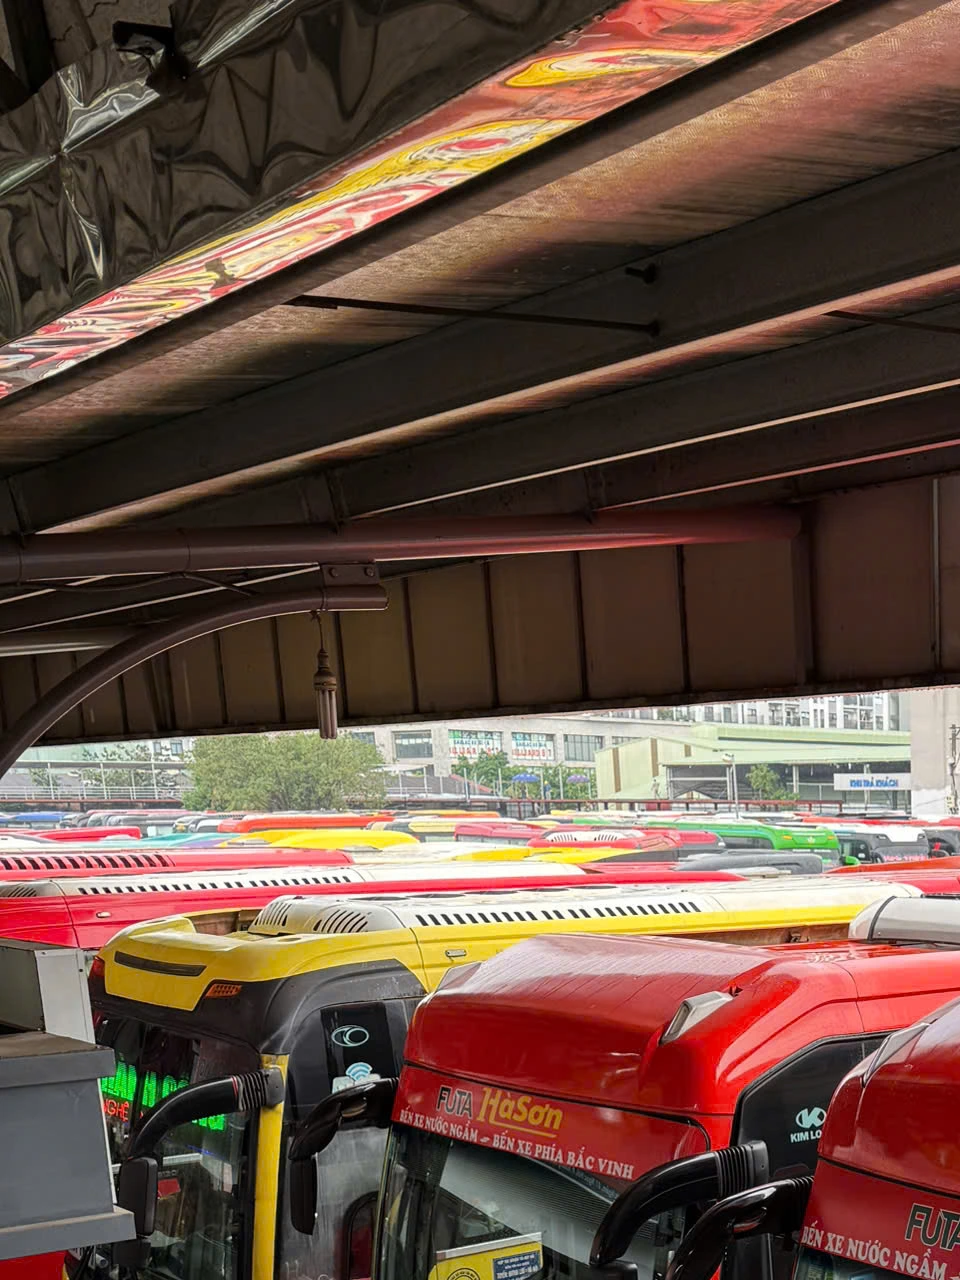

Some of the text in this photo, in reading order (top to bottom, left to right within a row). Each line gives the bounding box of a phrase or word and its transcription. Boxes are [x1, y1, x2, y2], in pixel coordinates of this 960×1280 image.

[436, 1086, 474, 1119] FUTA
[413, 1112, 425, 1128] XE
[492, 1130, 515, 1151] BẾN
[516, 1140, 532, 1155] XE
[534, 1141, 564, 1165] PHÍA
[566, 1147, 594, 1171] BẮC
[598, 1158, 635, 1180] VINH
[790, 1131, 809, 1143] KIM
[824, 1231, 846, 1255] XE
[846, 1234, 891, 1269] NƯỚC
